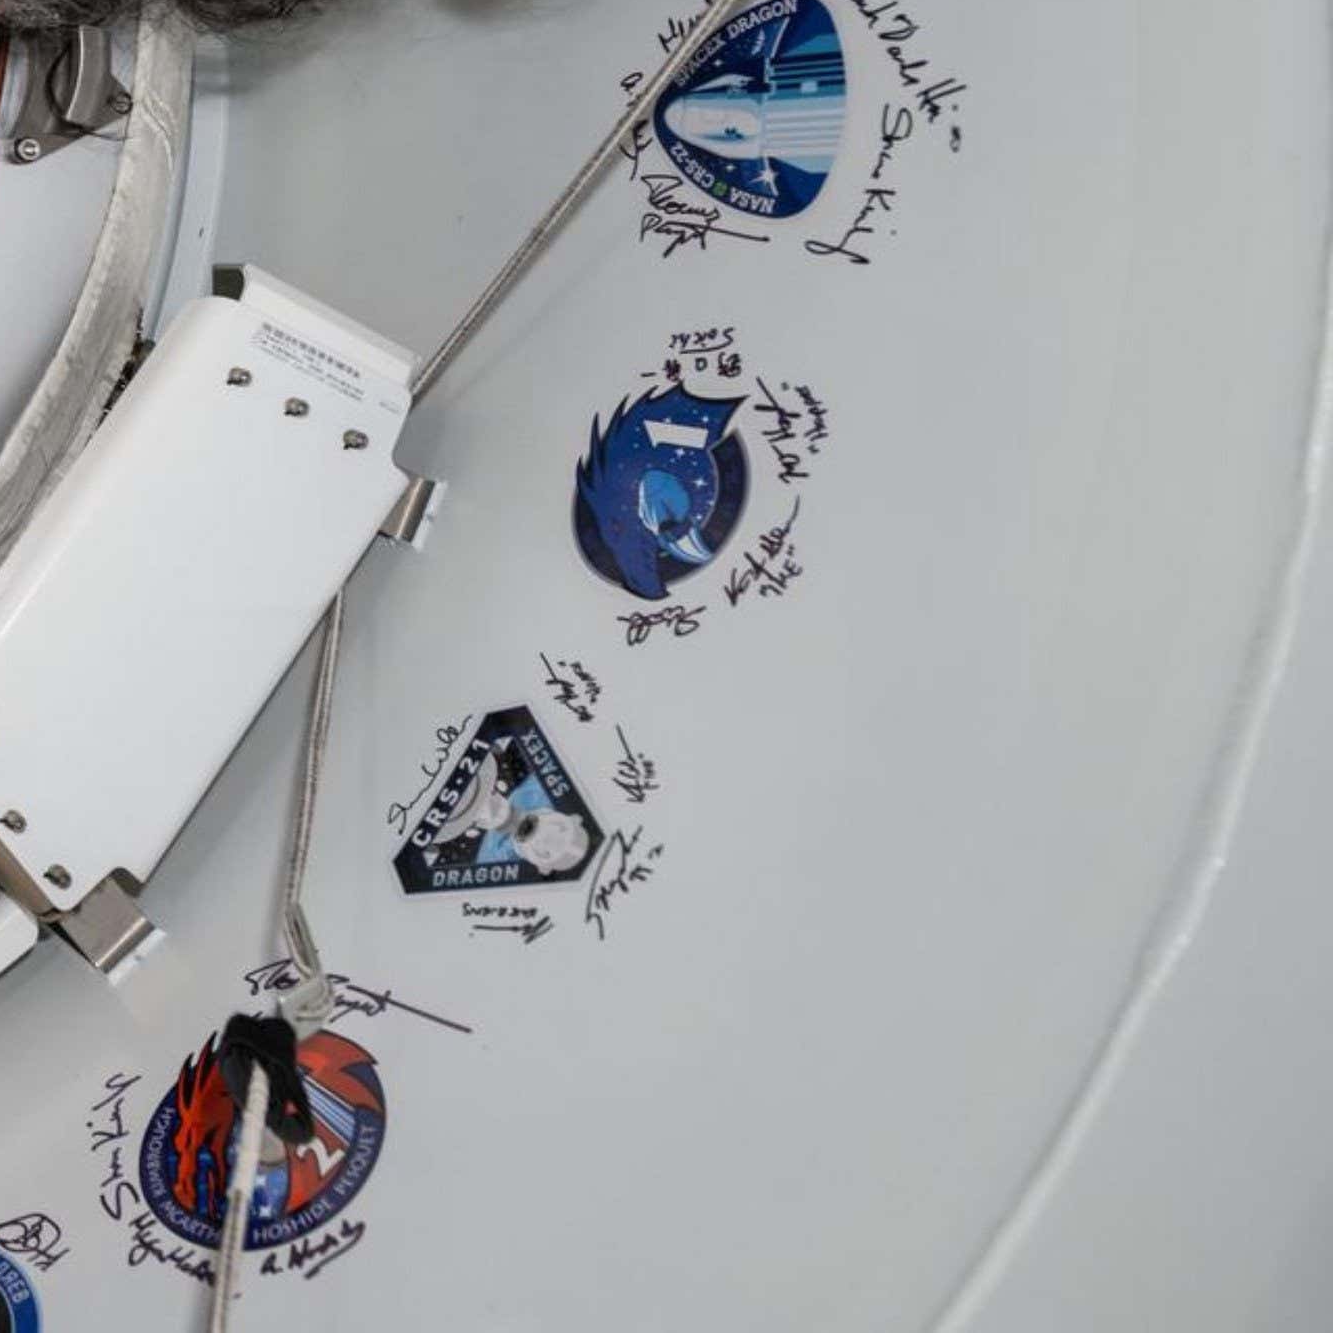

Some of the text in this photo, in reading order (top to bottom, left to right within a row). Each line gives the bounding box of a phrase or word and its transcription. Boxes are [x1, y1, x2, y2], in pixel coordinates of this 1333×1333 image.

[668, 141, 776, 214] NASA CRS-22
[521, 729, 572, 799] SPACEX
[432, 863, 521, 888] DRAGON
[335, 1123, 378, 1197] PESQUET
[251, 1198, 336, 1245] HOSHIDE
